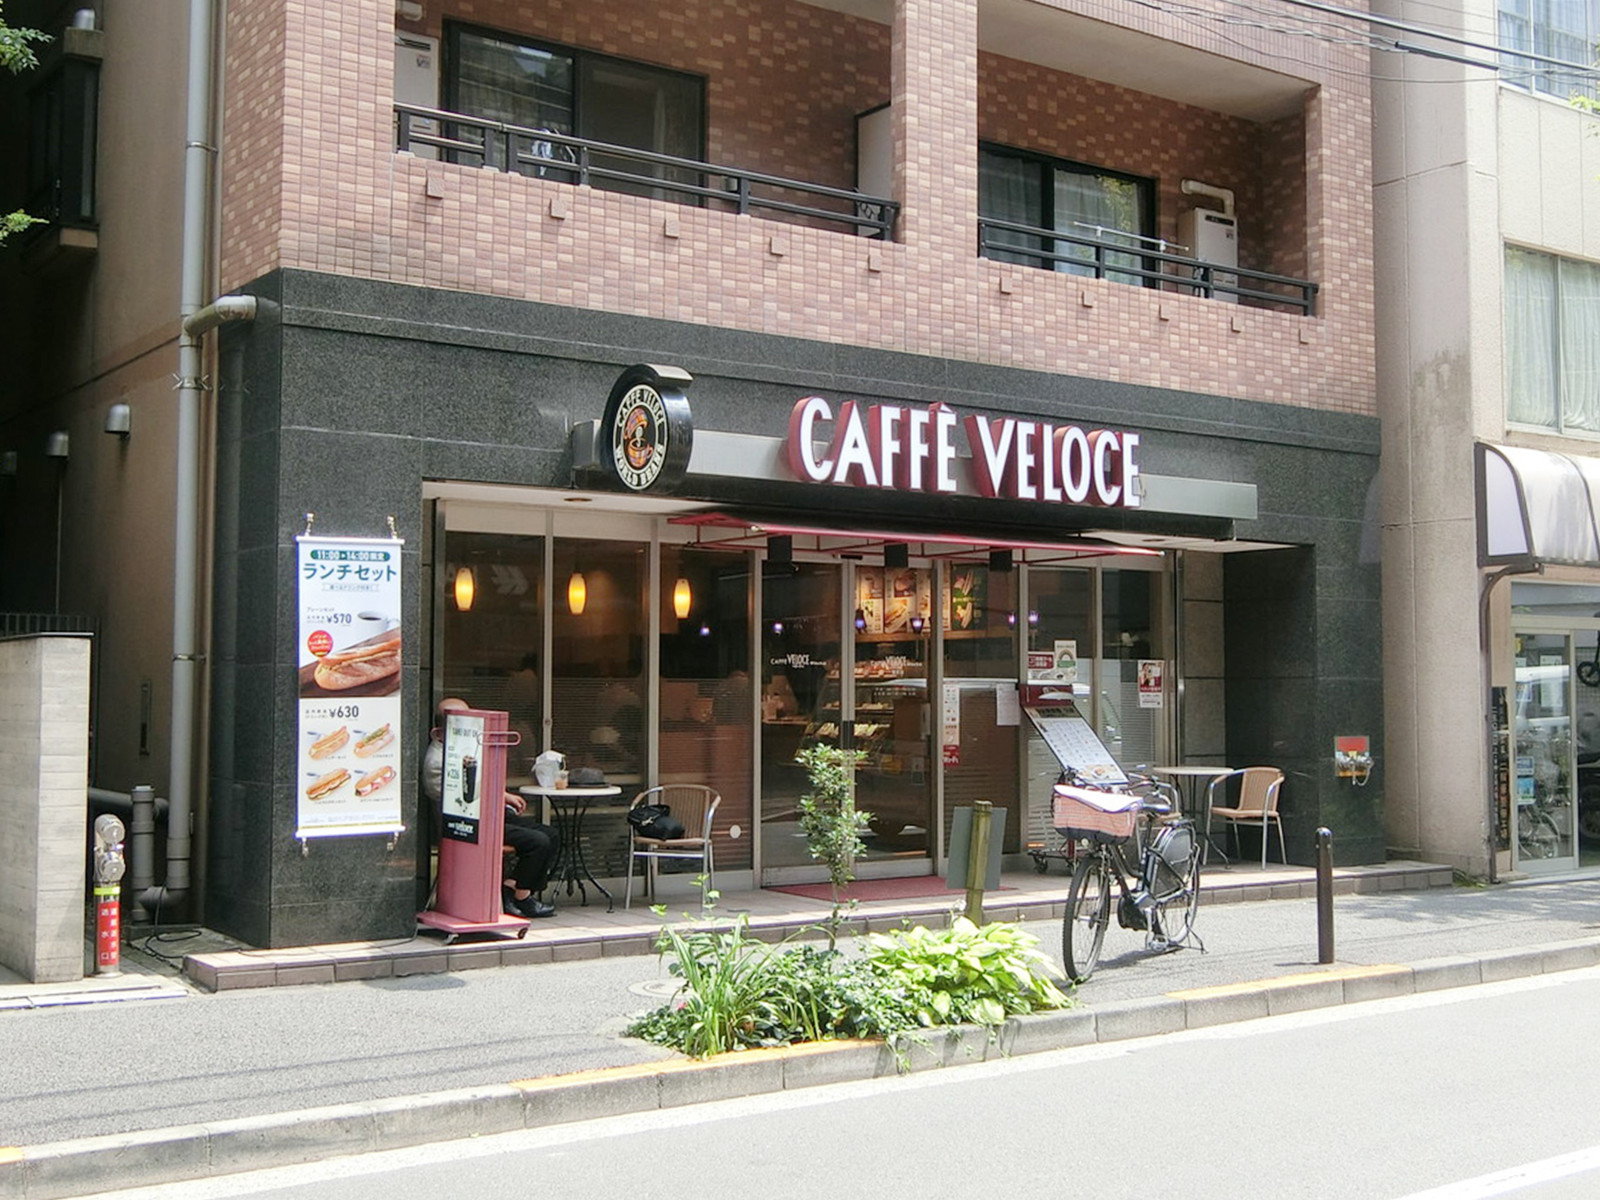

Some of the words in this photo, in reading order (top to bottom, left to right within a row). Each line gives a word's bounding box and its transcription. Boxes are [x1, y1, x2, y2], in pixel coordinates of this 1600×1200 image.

[615, 444, 639, 485] WORLD
[969, 415, 1141, 508] VELOCE
[317, 550, 340, 560] 11:00
[346, 551, 369, 561] 14:00
[303, 563, 397, 582] ランチセット
[326, 613, 352, 624] ¥570
[329, 705, 359, 718] ¥630
